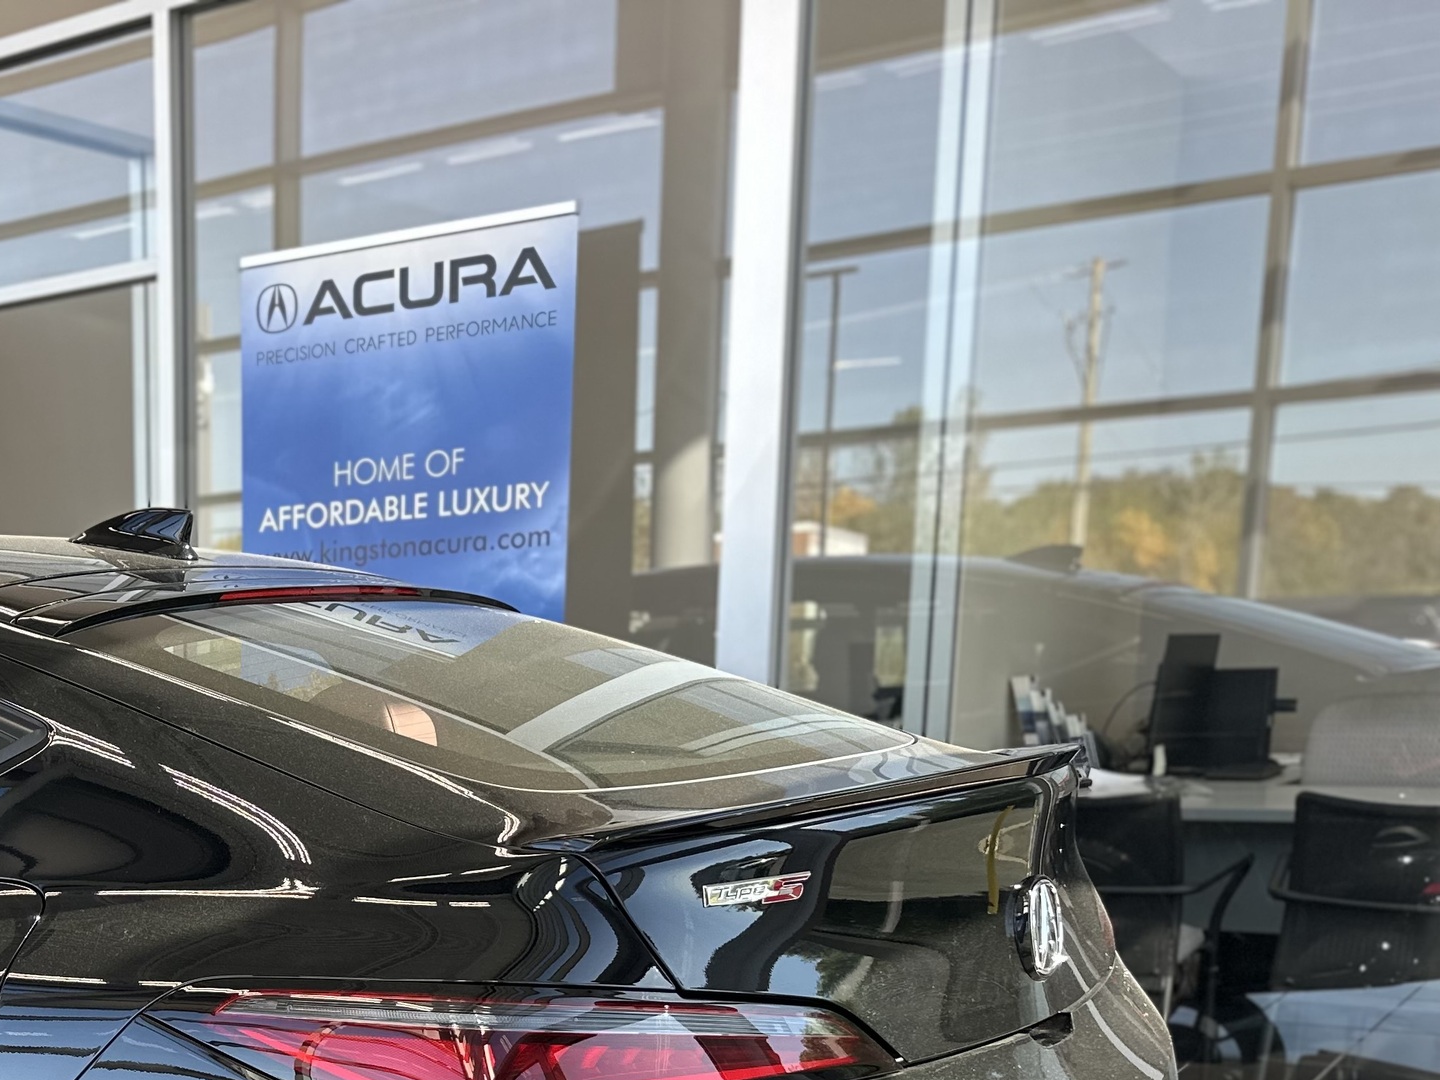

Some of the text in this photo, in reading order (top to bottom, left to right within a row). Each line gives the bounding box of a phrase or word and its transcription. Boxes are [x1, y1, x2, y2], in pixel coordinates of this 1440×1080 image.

[303, 247, 557, 325] ACURA
[256, 310, 557, 366] PRECISION CRAFTED PERFORMANCE
[334, 448, 465, 487] HOME OF
[259, 481, 550, 533] AFFORDABLE LUXURY
[265, 528, 550, 566] w.kingstonacura.com
[762, 871, 812, 904] S
